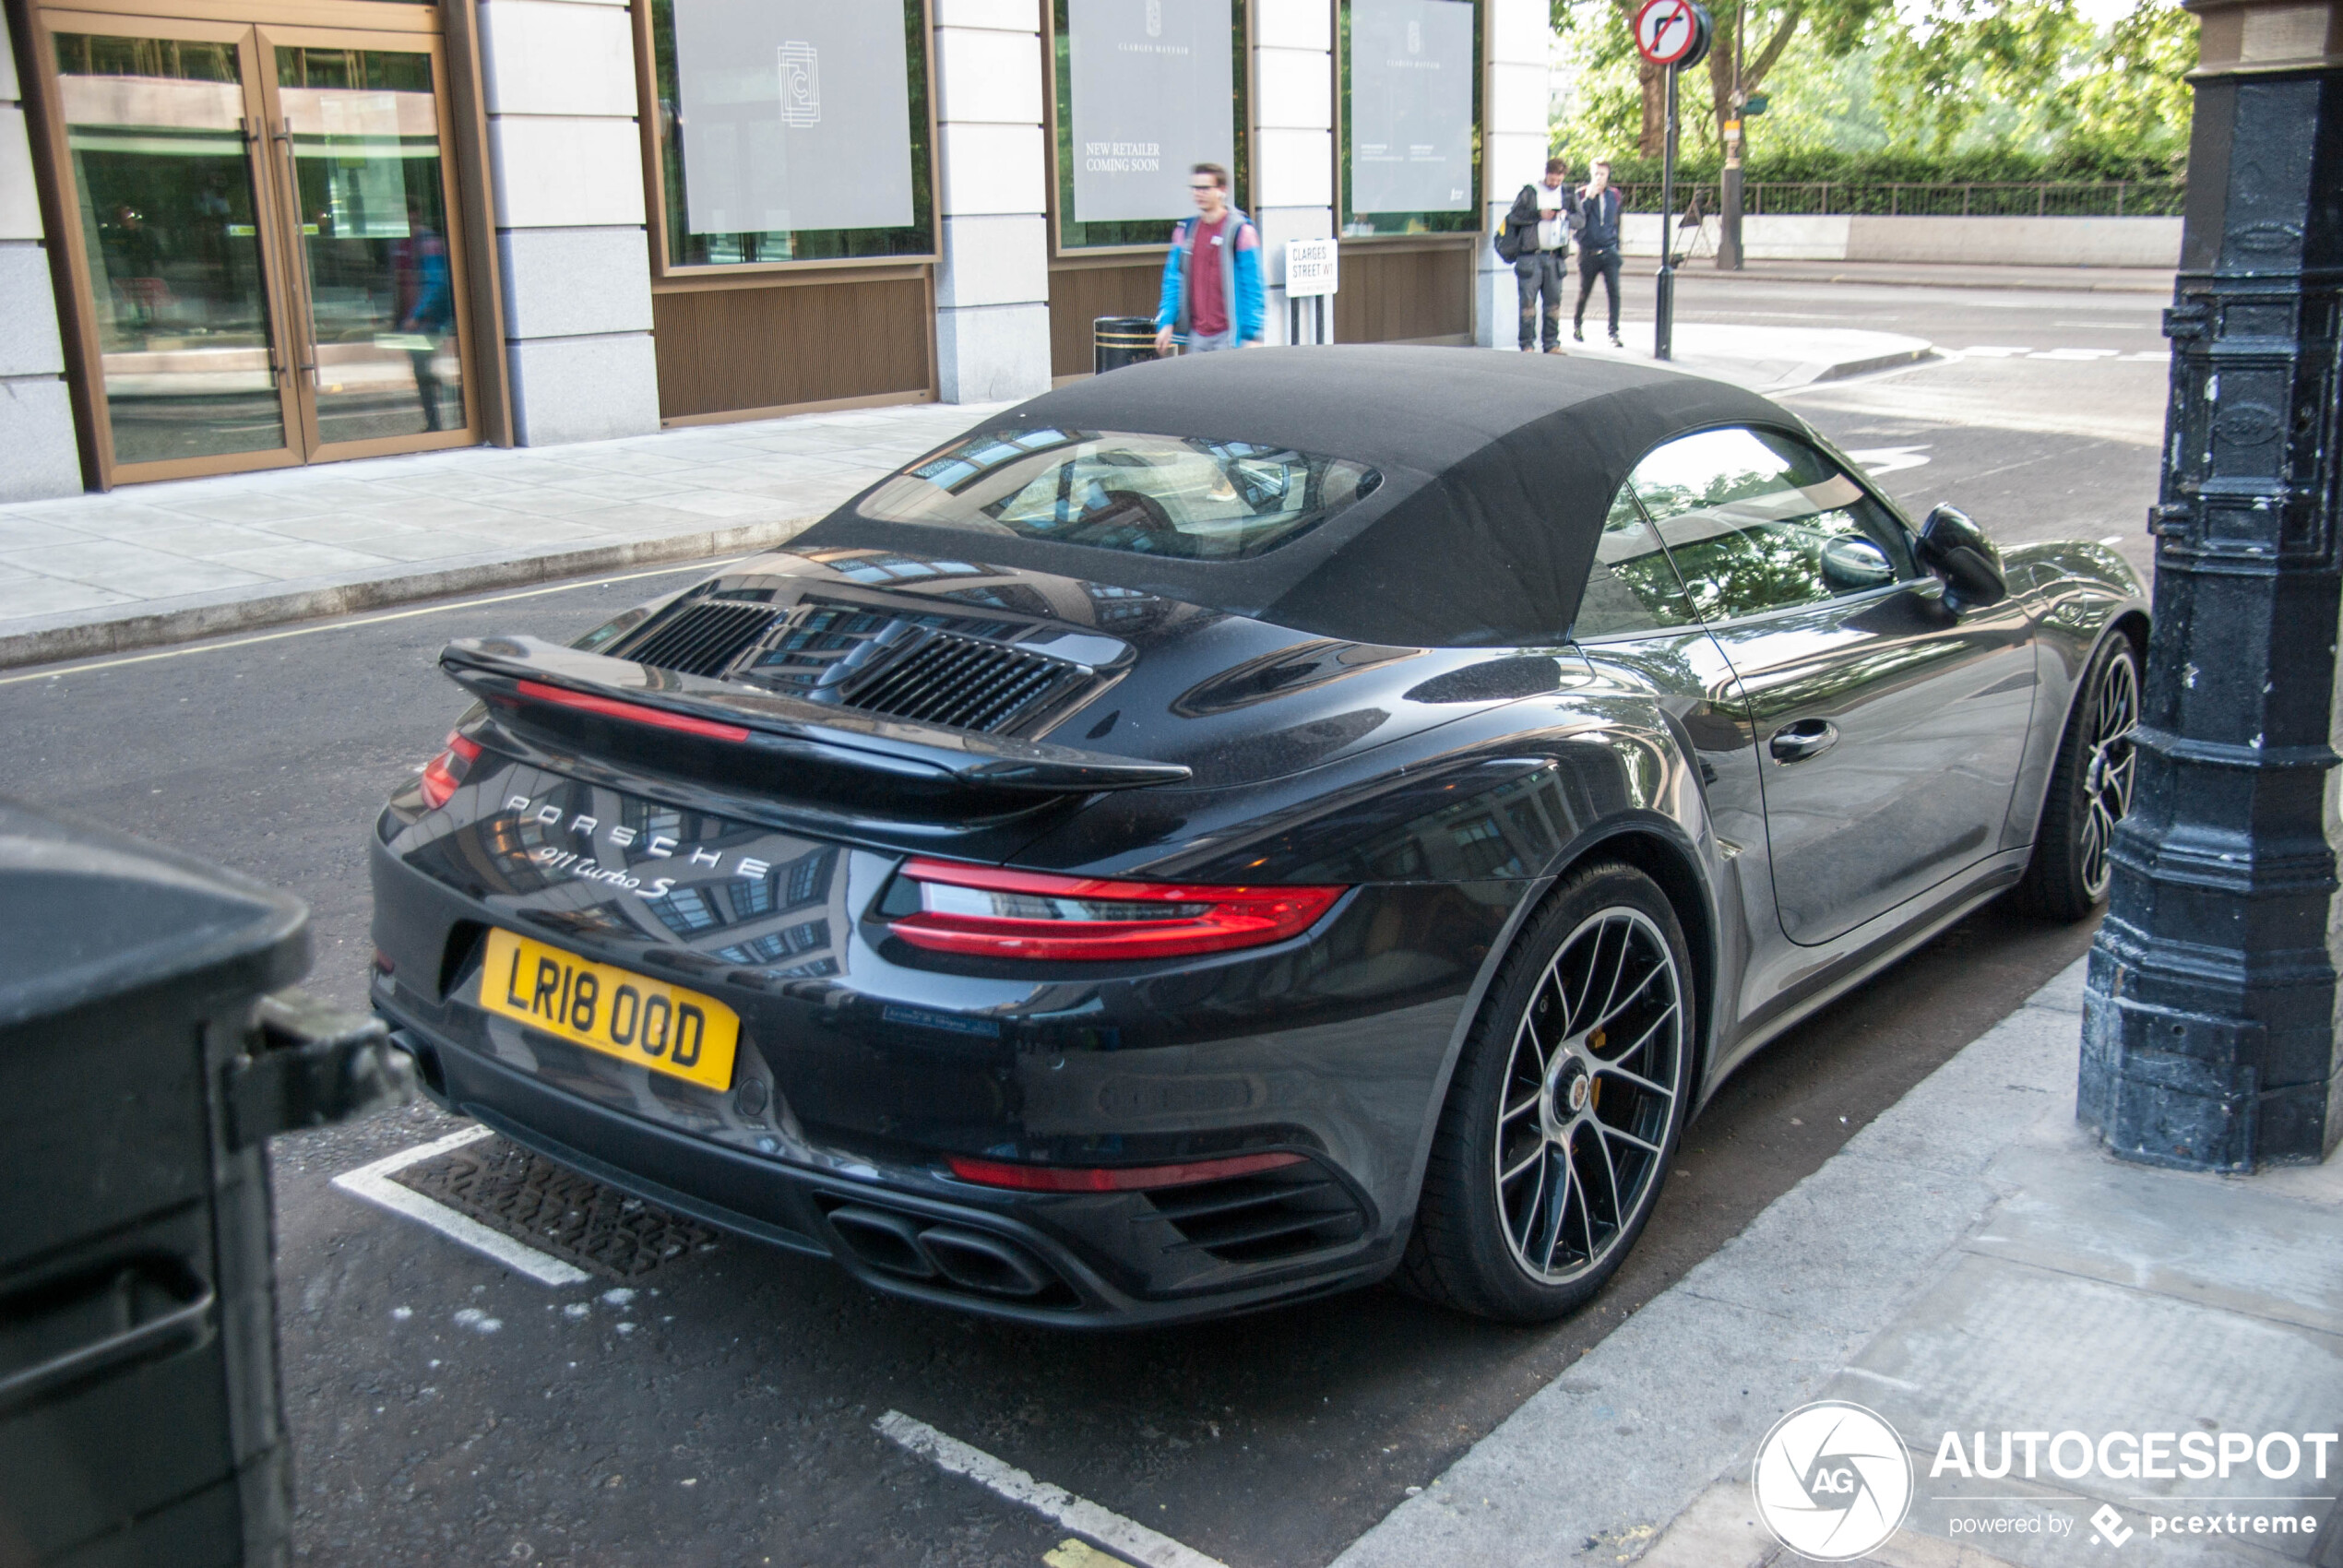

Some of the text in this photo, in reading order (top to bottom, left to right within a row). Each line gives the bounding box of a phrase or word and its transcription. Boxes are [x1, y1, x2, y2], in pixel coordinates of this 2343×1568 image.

[1086, 142, 1160, 156] NEW RETAILER
[1086, 158, 1160, 172] COMING SOON
[1292, 246, 1326, 261] CLARGES
[1292, 263, 1333, 279] STREET W1
[507, 795, 770, 880] PORSCHE
[538, 846, 677, 899] 911 turbo S
[506, 947, 600, 1033] LR18
